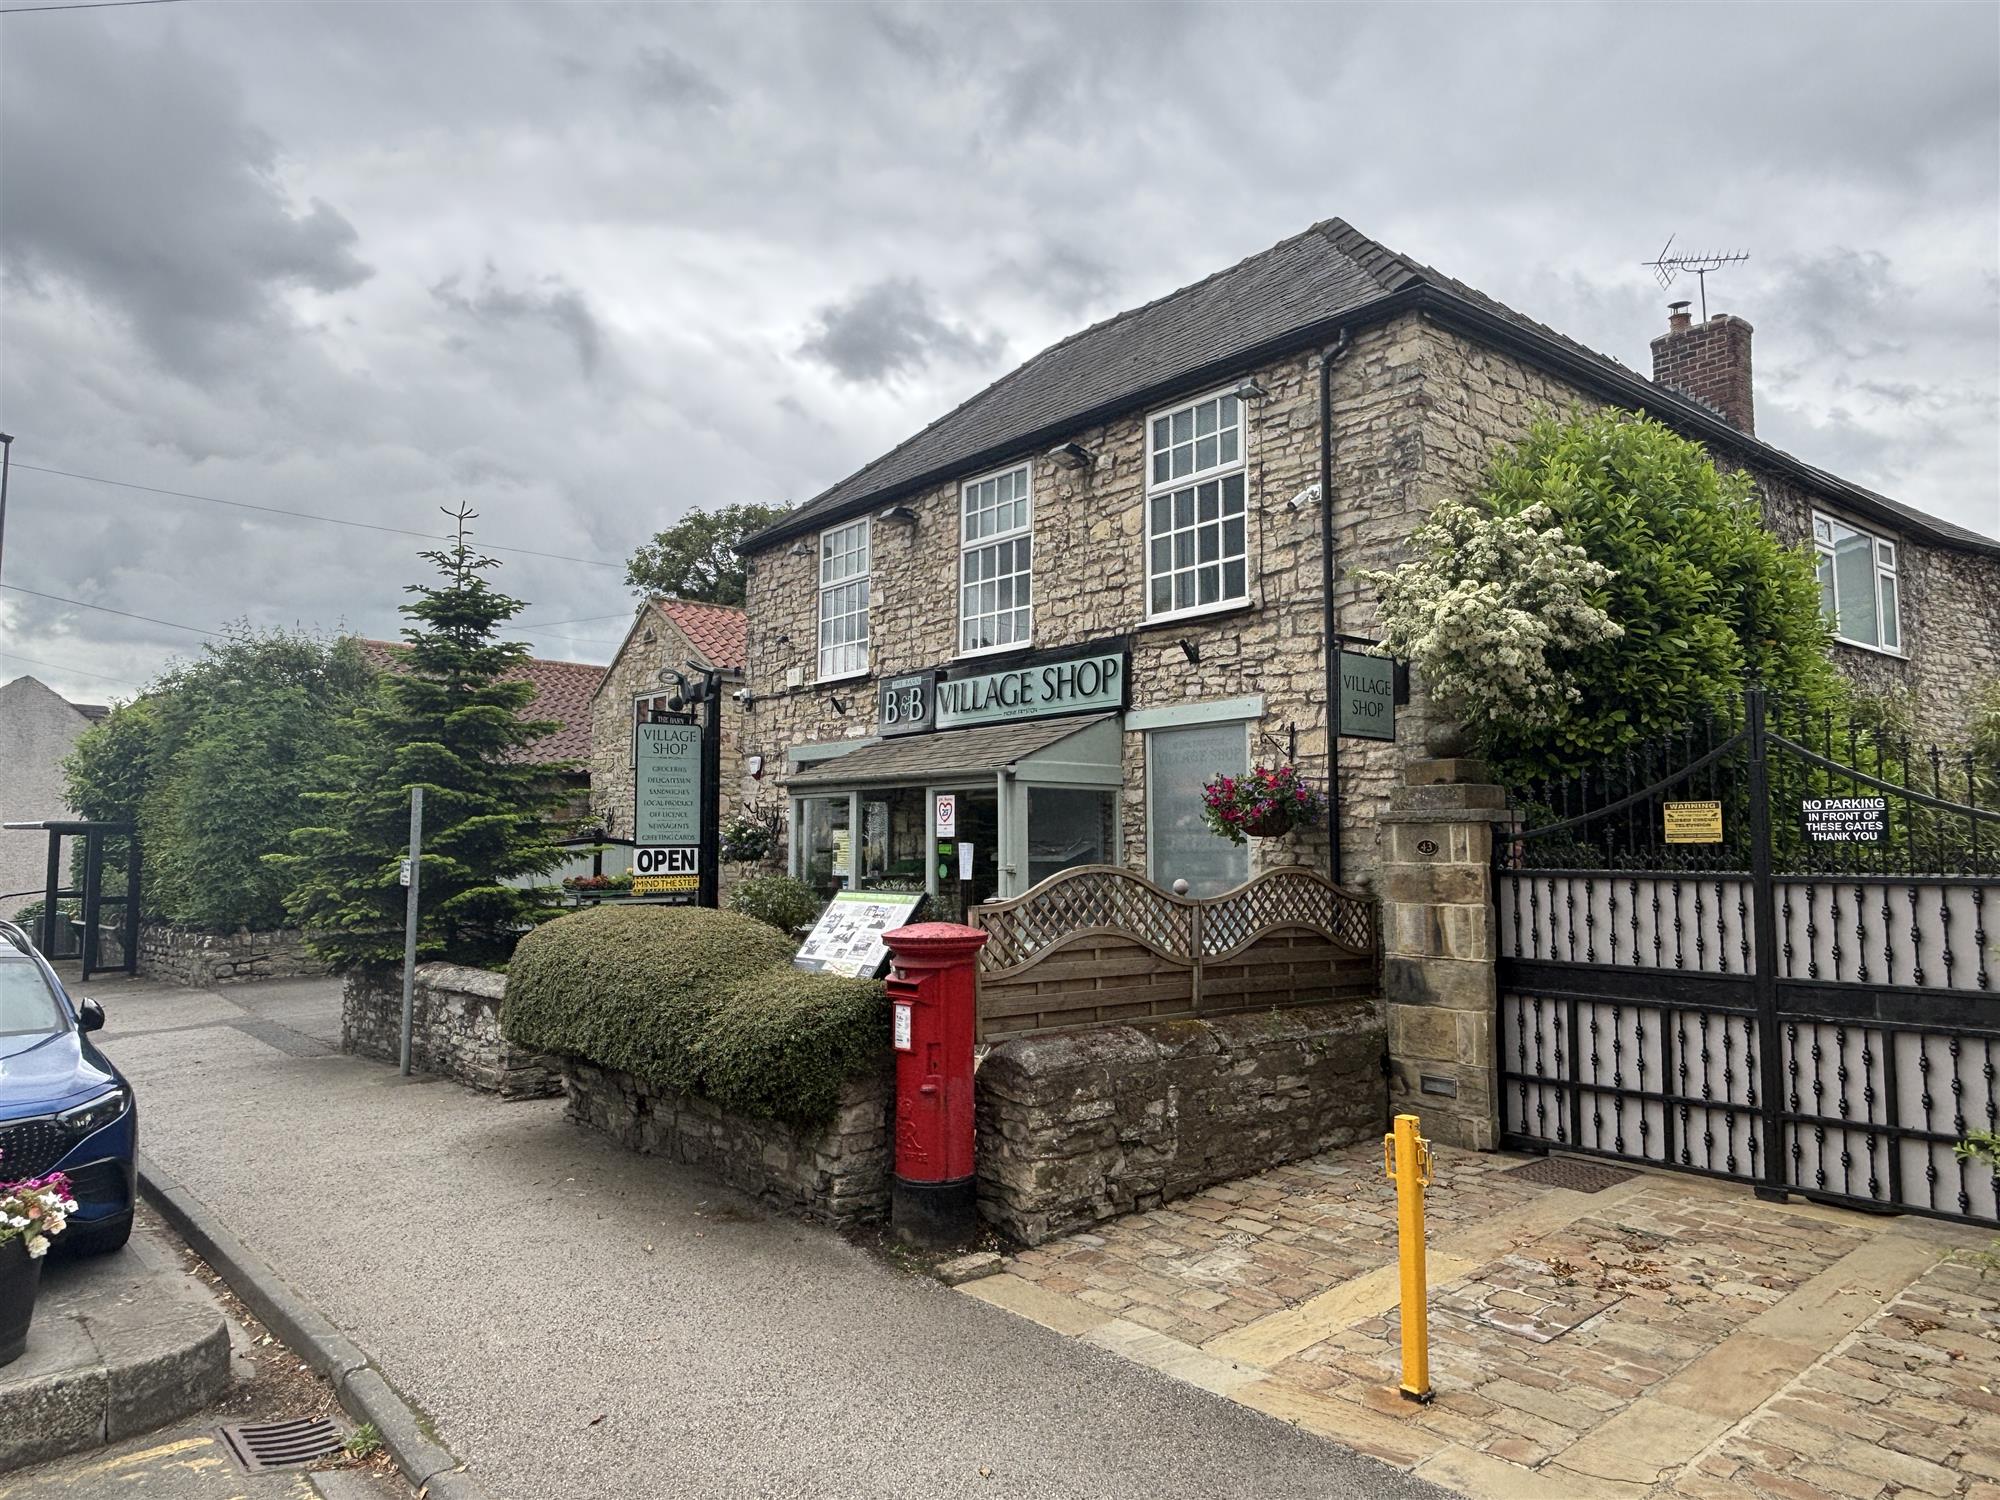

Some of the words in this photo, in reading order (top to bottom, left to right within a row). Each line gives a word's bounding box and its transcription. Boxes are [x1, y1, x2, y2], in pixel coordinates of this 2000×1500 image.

[937, 671, 1034, 715] VILLAGE
[1041, 658, 1118, 701] SHOP
[1343, 675, 1392, 696] VILLAGE
[884, 687, 924, 724] B&B
[1352, 700, 1384, 718] SHOP
[643, 728, 697, 743] VILLAGE
[652, 742, 688, 755] SHOP
[1802, 800, 1822, 810] NO
[1825, 797, 1885, 809] PARKING
[1808, 812, 1819, 821] IN
[1822, 811, 1861, 821] FRONT
[1863, 811, 1880, 820] OF
[1805, 822, 1842, 832] THESE
[1845, 821, 1884, 831] GATES
[1811, 832, 1851, 841] THANK
[1853, 831, 1878, 841] YOU
[637, 849, 695, 872] OPEN
[636, 880, 660, 888] MIND
[660, 879, 677, 887] THE
[678, 879, 698, 887] STEP
